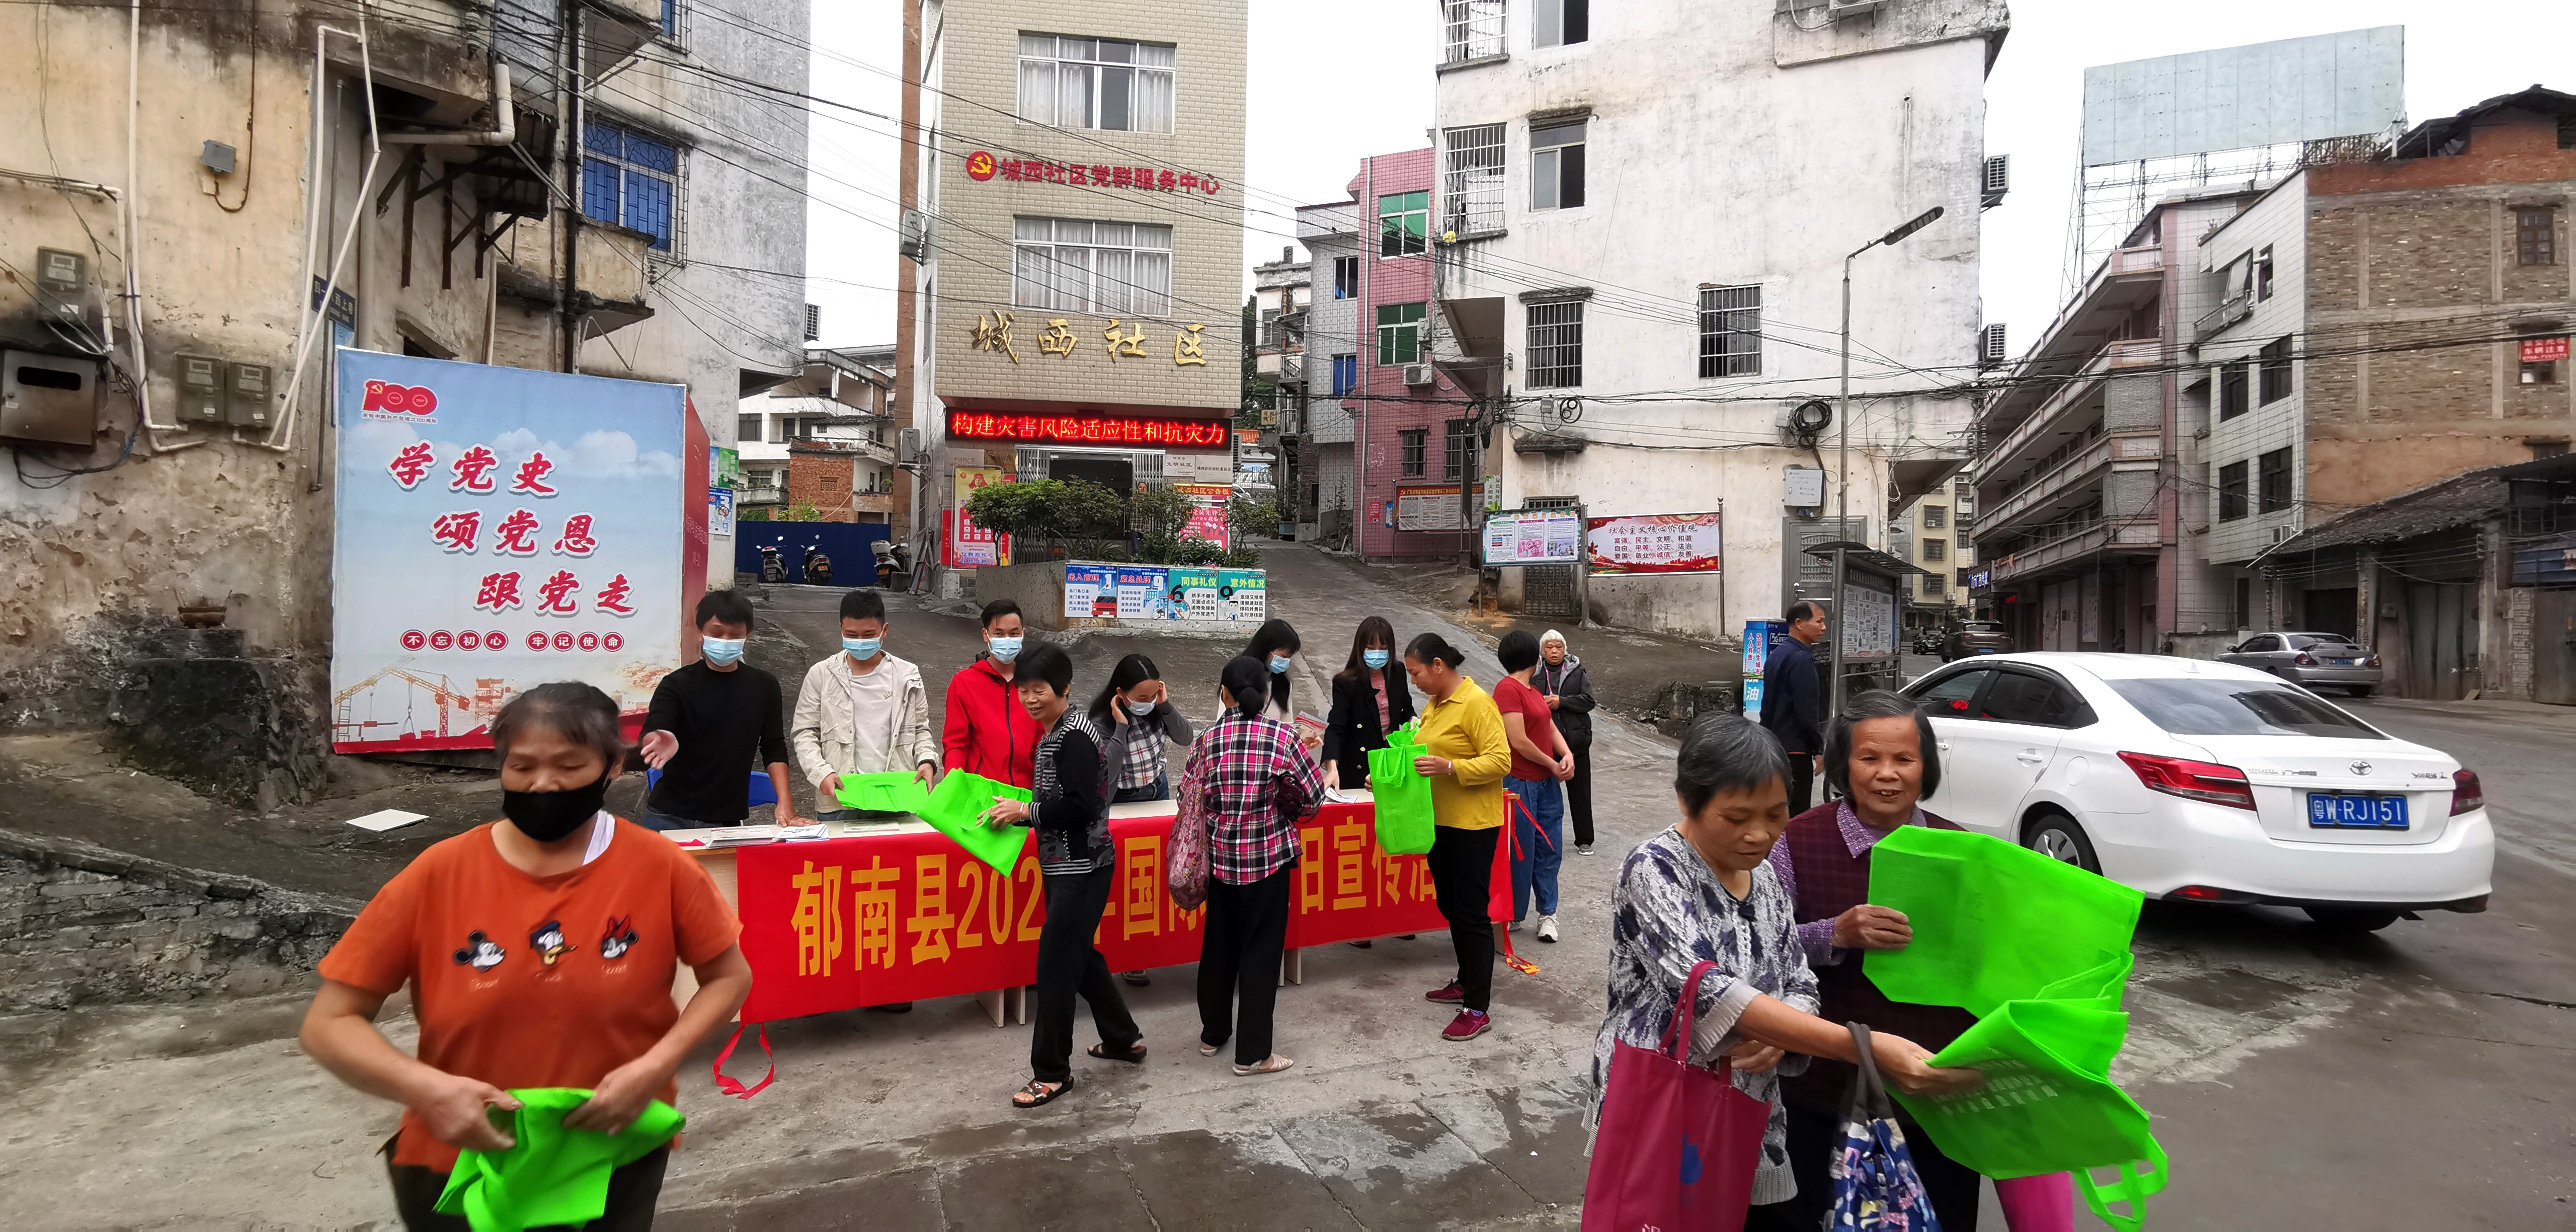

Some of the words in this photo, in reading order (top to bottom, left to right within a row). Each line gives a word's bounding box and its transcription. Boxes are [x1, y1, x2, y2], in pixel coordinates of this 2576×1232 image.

[1001, 157, 1220, 195] 城西社区党群服务中心
[971, 310, 1206, 366] 城西社区
[952, 414, 1225, 444] 构建灾害风险适应性和抗灾力
[389, 442, 556, 494] 学党史
[433, 509, 598, 553] 颂党恩
[1608, 524, 1697, 534] 社会主义核心价值观
[1068, 573, 1099, 582] 出入管理
[1120, 575, 1151, 584] 紧急处理
[1181, 577, 1217, 587] 同事礼仪
[1231, 578, 1264, 588] 意外情况
[476, 571, 634, 612] 跟党走
[405, 634, 505, 648] 不忘初心
[530, 634, 621, 649] 牢记使命
